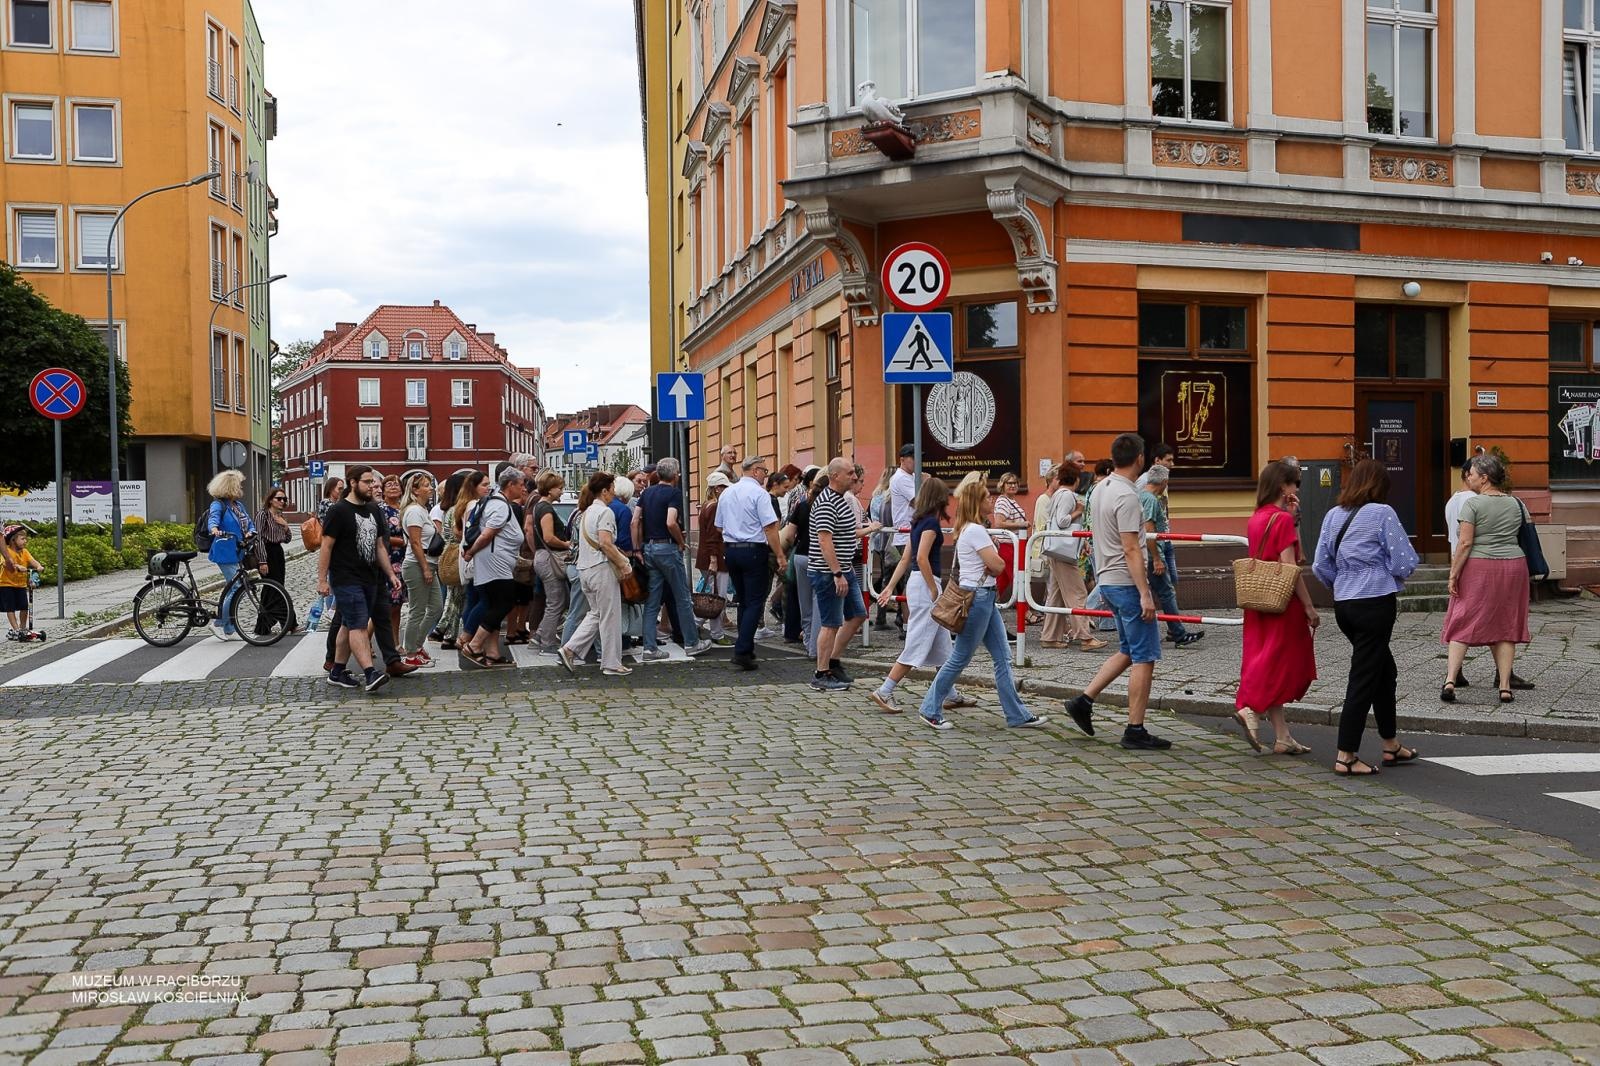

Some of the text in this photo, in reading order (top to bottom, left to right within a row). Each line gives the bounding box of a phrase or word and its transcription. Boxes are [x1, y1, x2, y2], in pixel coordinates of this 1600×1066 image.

[897, 261, 941, 295] 20
[568, 432, 582, 450] P
[312, 462, 321, 473] P
